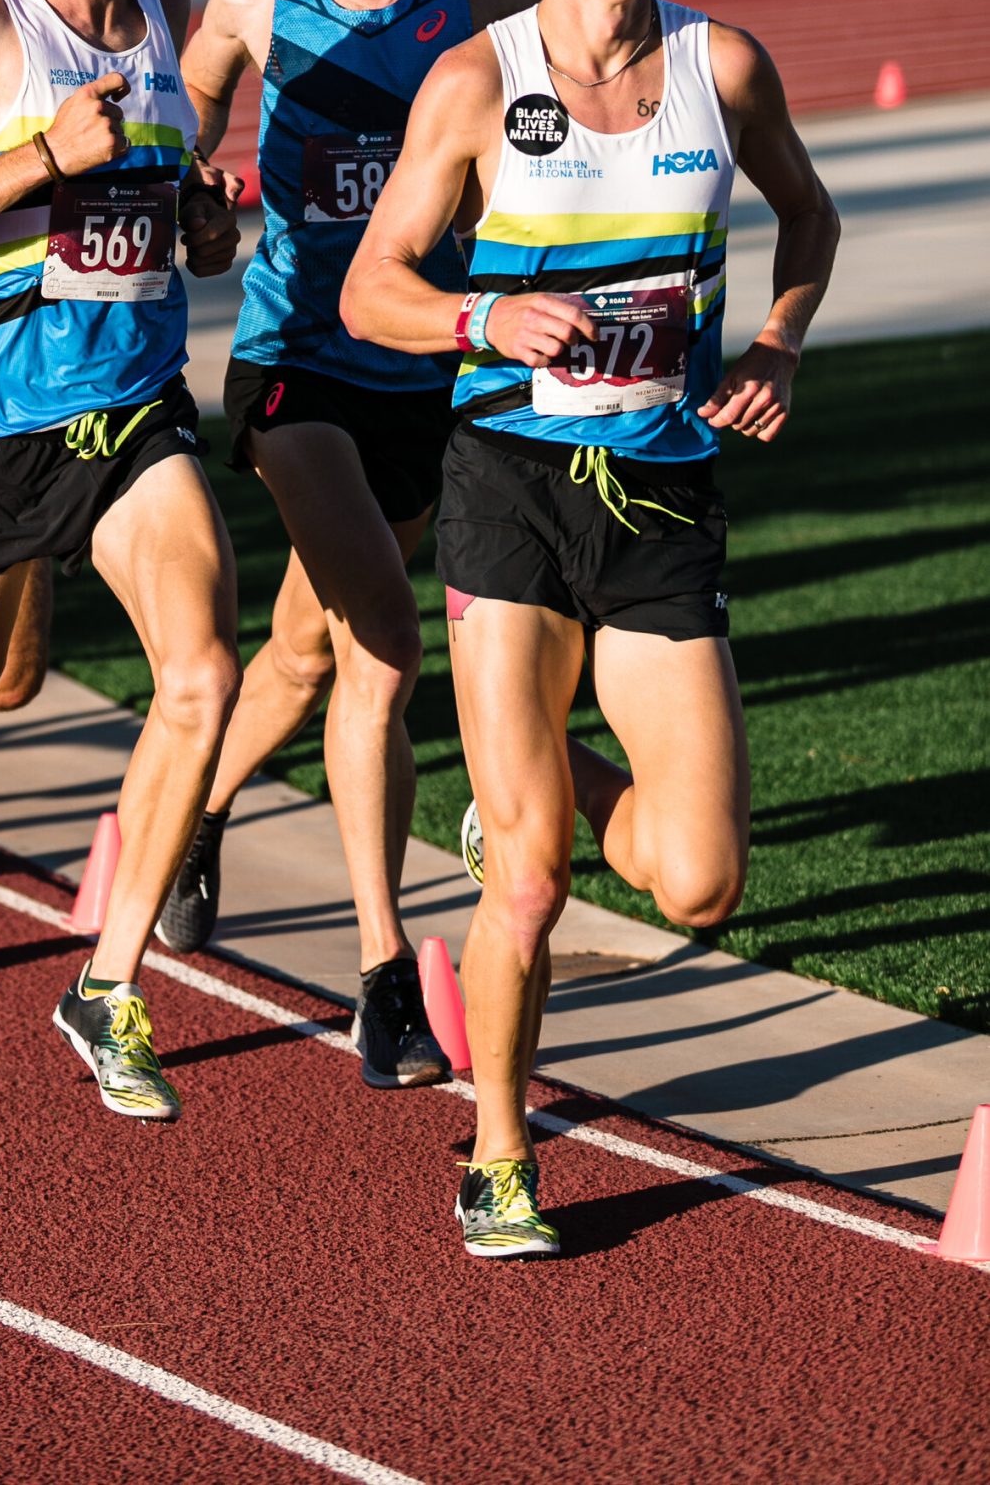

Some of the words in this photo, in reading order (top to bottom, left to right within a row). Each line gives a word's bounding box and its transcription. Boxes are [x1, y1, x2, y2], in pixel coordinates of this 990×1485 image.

[144, 72, 178, 95] HOKA
[515, 108, 558, 120] BLACK
[517, 119, 555, 131] LIVES
[509, 128, 563, 142] MATTER
[529, 158, 588, 169] NORTHERN
[652, 149, 719, 176] HOKA
[529, 168, 574, 178] ARIZONA
[577, 169, 603, 179] ELITE
[335, 162, 396, 212] 58
[81, 216, 152, 267] 569
[570, 323, 654, 381] 572
